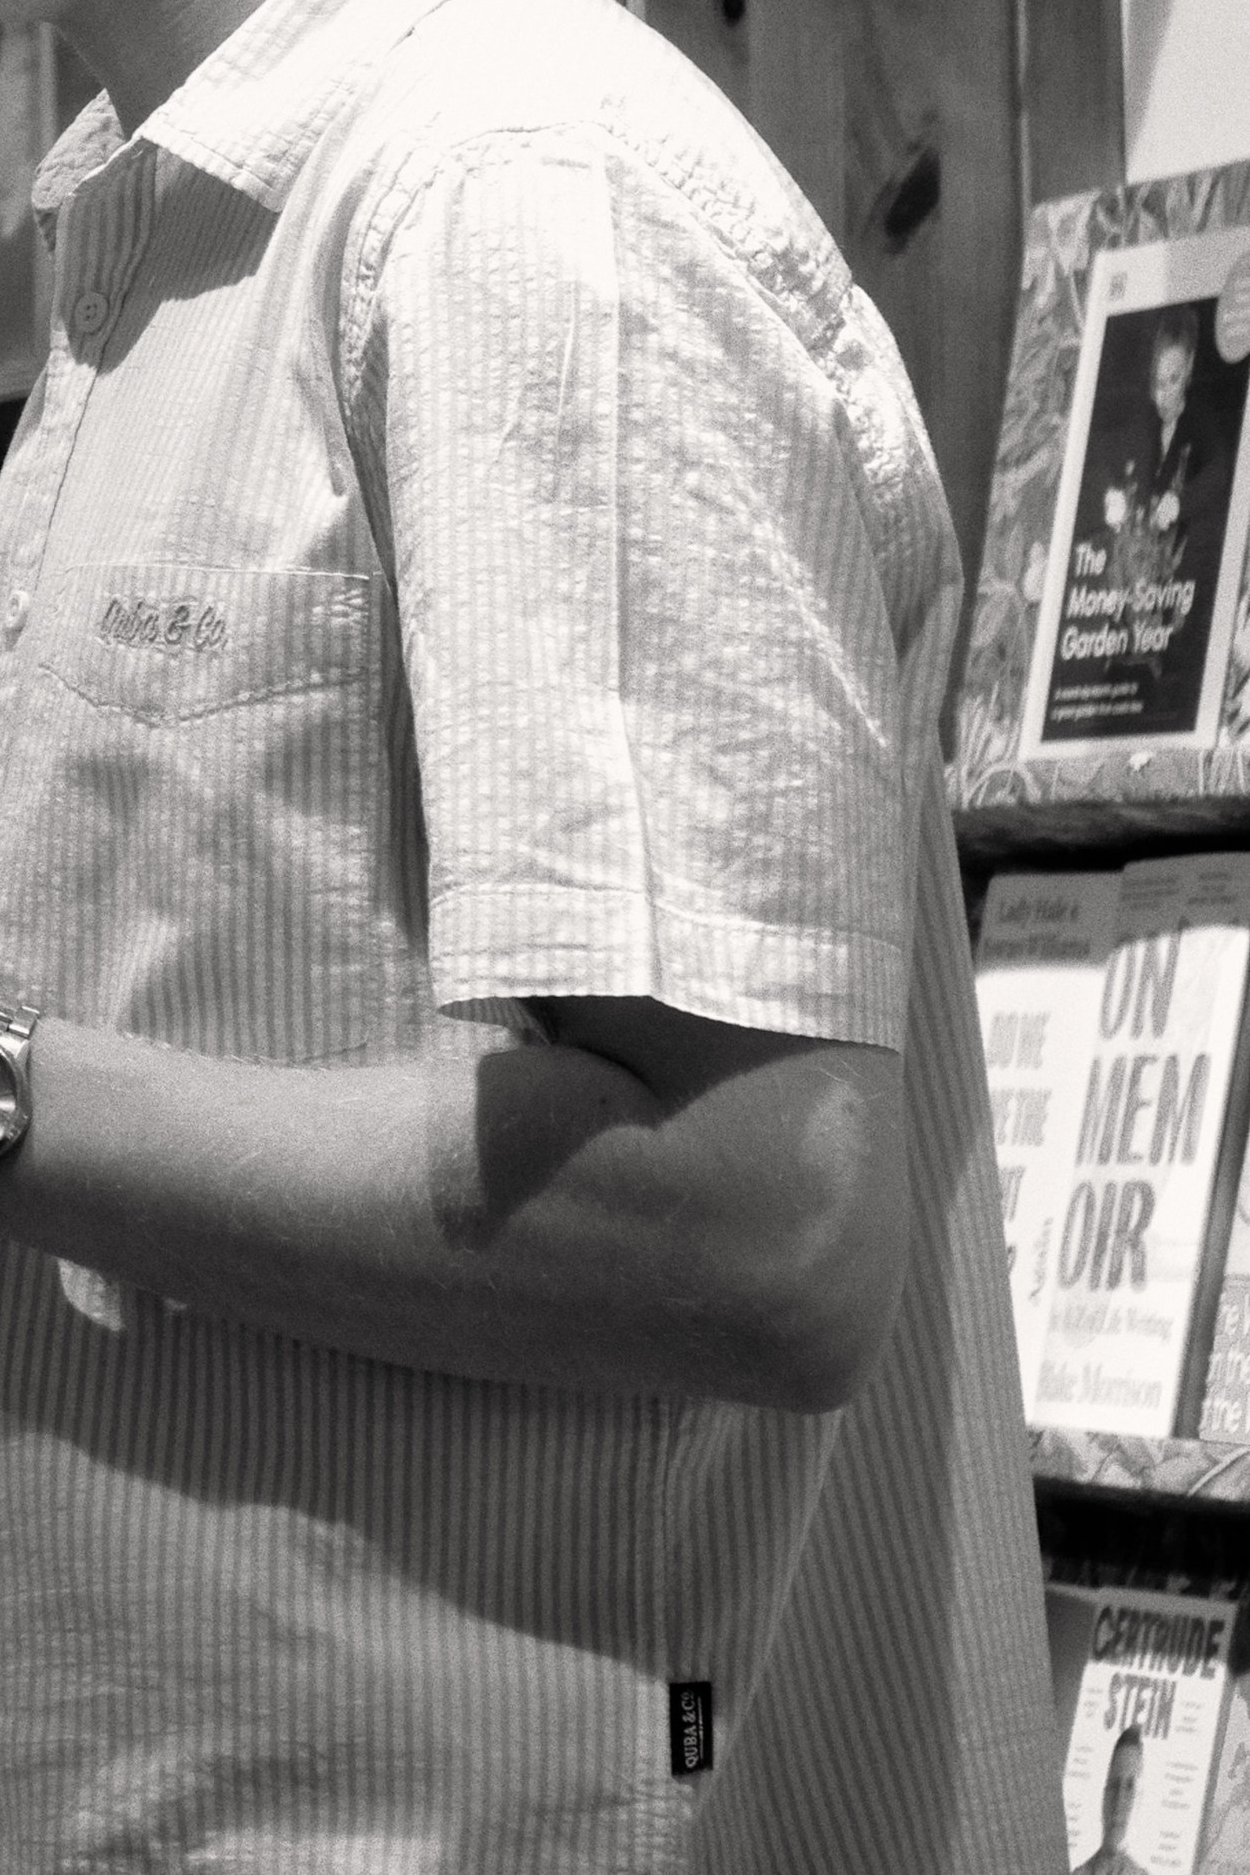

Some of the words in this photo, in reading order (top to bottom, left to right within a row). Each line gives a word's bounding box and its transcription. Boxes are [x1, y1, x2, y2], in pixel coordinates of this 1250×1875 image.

[1074, 541, 1108, 578] The
[1066, 576, 1197, 624] Money-Saving
[1060, 622, 1129, 661] Garden
[1133, 620, 1175, 654] Year
[1098, 917, 1190, 1040] ON
[1074, 1052, 1212, 1166] MEM
[1057, 1178, 1156, 1293] OIR
[1093, 1605, 1226, 1681] GERTRUDE
[1103, 1672, 1178, 1741] STEIN
[683, 1724, 699, 1768] QUBA
